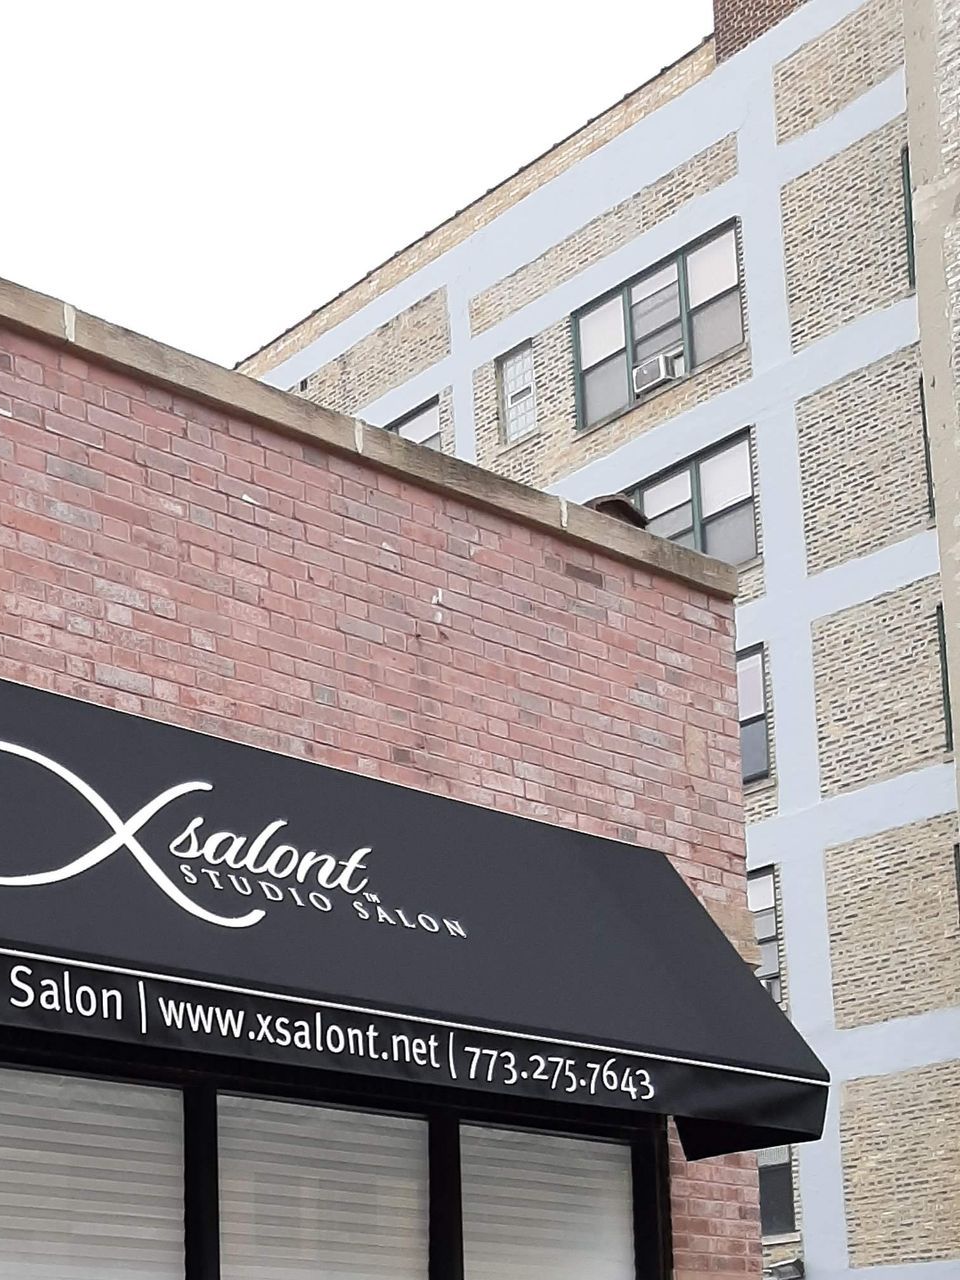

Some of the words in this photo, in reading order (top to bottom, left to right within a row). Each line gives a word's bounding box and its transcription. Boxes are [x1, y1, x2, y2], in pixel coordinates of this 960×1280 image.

[179, 863, 333, 913] STUDIO
[352, 900, 468, 940] SALON
[10, 965, 123, 1021] Salon
[158, 996, 441, 1069] www.xsalont.net
[463, 1046, 656, 1101] 773.275.7643
